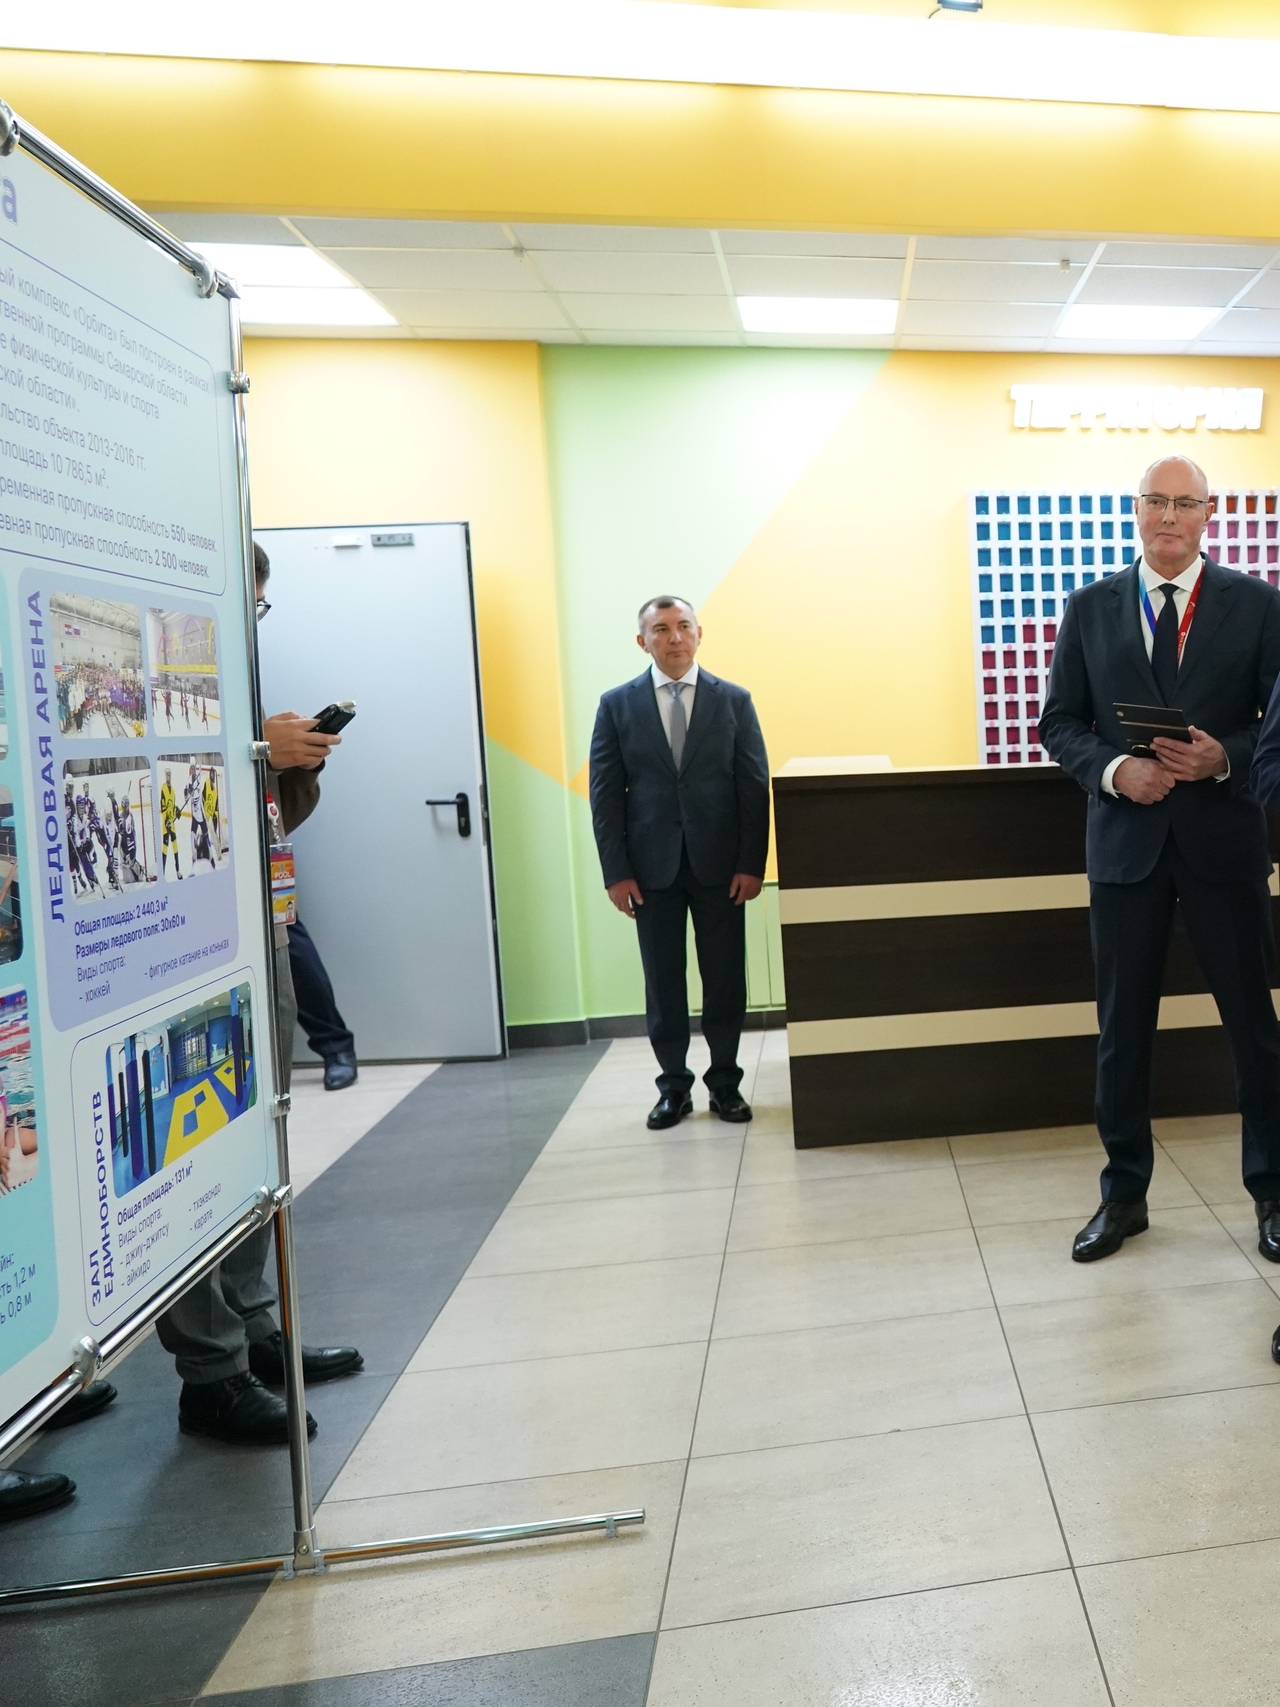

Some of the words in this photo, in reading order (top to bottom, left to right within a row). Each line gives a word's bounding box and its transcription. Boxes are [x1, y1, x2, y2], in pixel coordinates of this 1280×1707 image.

[18, 277, 70, 318] комплекс
[73, 306, 117, 341] «Орбита»
[120, 329, 137, 354] был
[139, 343, 176, 375] построен
[178, 365, 183, 379] в
[184, 368, 210, 394] рамках
[10, 333, 75, 381] физической
[77, 369, 121, 402] культуры
[123, 390, 129, 406] и
[130, 394, 160, 420] спорта
[47, 323, 105, 365] программы
[107, 351, 155, 390] Самарской
[156, 379, 188, 407] области
[1010, 384, 1264, 430] ТЕРРИТОРИЯ
[43, 417, 86, 448] объекта
[88, 431, 135, 467] 2013-2016
[136, 455, 147, 471] гг.
[50, 452, 63, 474] 10
[65, 457, 93, 486] 786,5
[58, 492, 114, 523] пропускная
[117, 511, 169, 539] способность
[171, 523, 186, 543] 550
[187, 531, 217, 553] человек.
[34, 521, 95, 551] пропускная
[97, 538, 153, 565] способность
[154, 548, 160, 566] 2
[162, 550, 177, 570] 500
[179, 558, 210, 579] человек.
[27, 590, 50, 726] АРЕНА
[38, 735, 65, 923] ЛЕДОВАЯ
[274, 871, 291, 880] POOL
[74, 918, 101, 936] Общая
[101, 909, 136, 928] площадь:
[135, 904, 141, 919] 2
[142, 899, 160, 917] 440,3
[75, 936, 110, 959] Размеры
[110, 928, 142, 949] ледового
[143, 922, 160, 938] поля:
[180, 914, 186, 926] м
[77, 962, 98, 983] Виды
[99, 955, 126, 975] спорта:
[149, 956, 178, 981] фигурное
[178, 948, 201, 967] катание
[201, 946, 209, 957] на
[209, 937, 229, 955] коньках
[85, 980, 111, 1002] хоккей
[92, 1090, 114, 1298] ЕДИНОБОРСТВ
[117, 1201, 142, 1226] Общая
[142, 1178, 174, 1208] площадь:
[174, 1167, 185, 1186] 131
[192, 1182, 221, 1213] тхэквондо
[118, 1227, 137, 1248] Виды
[138, 1207, 163, 1236] спорта:
[194, 1208, 213, 1233] карате
[125, 1222, 170, 1265] джиу-джитсу
[13, 1266, 27, 1289] 1,2
[28, 1263, 36, 1279] м
[89, 1249, 101, 1307] ЗАЛ
[126, 1258, 151, 1287] айкидо
[8, 1295, 22, 1318] 0,8
[24, 1291, 32, 1307] м
